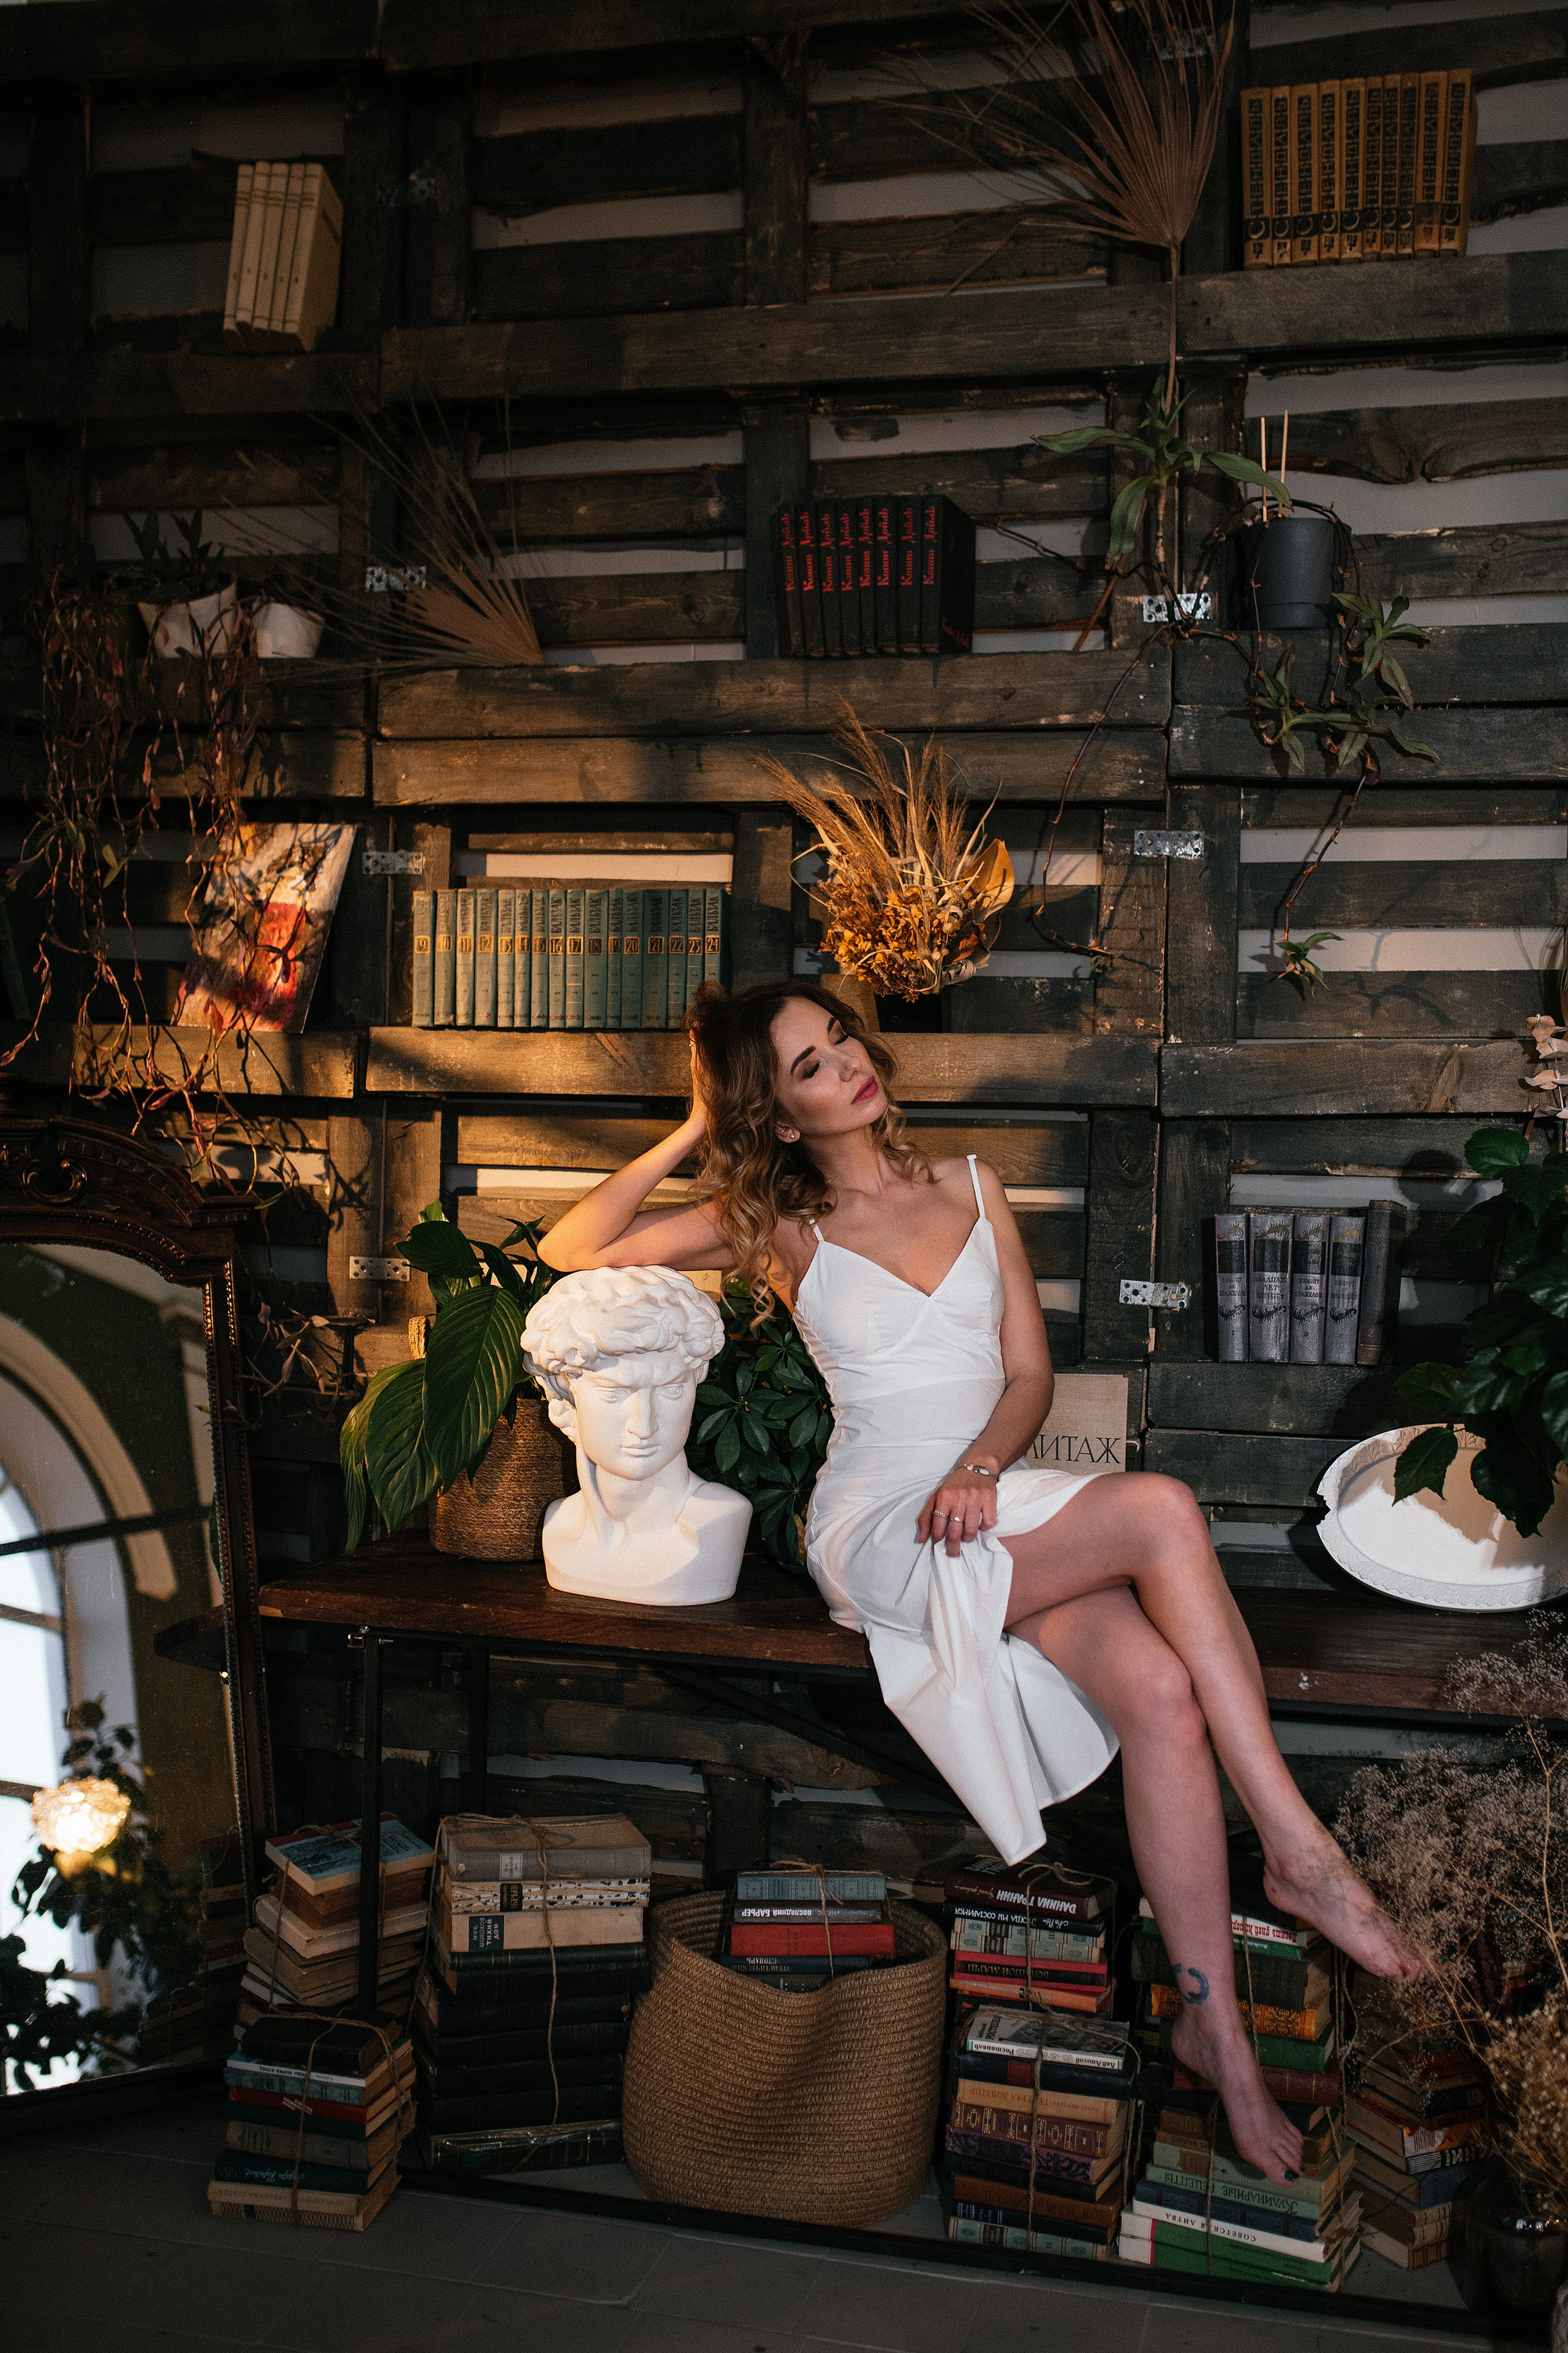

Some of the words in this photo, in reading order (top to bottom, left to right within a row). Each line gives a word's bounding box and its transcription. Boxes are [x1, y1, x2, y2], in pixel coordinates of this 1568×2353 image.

[1248, 99, 1265, 239] СТЕНДАЛЬ
[1274, 97, 1289, 238] СТЕНДАЛЬ
[1296, 95, 1313, 236] СТЕНДАЛЬ
[1321, 94, 1336, 232] СТЕНДАЛЬ
[1343, 89, 1360, 230] СТЕНДАЛЬ
[1364, 88, 1381, 227] СТЕНДАЛЬ
[781, 513, 795, 548] Дойль
[799, 512, 815, 547] Дойль
[820, 513, 835, 549] Дойль
[839, 513, 854, 548] Дойль
[858, 508, 873, 544] Дойль
[876, 508, 892, 544] Дойль
[901, 507, 916, 543] Дойль
[924, 506, 938, 543] Дойль
[785, 556, 795, 591] Конан
[803, 554, 814, 591] Конан
[822, 556, 834, 592] Конан
[841, 555, 853, 591] Конан
[859, 550, 870, 587] Конан
[877, 550, 889, 586] Конан
[900, 550, 913, 586] Конан
[922, 549, 935, 585] Конан
[480, 898, 492, 931] БАЛЬЗАК
[501, 898, 512, 932] БАЛЬЗАК
[534, 897, 545, 932] БАЛЬЗАК
[551, 897, 562, 934] БАЛЬЗАК
[570, 897, 581, 933] БАЛЬЗАК
[589, 897, 601, 934] БАЛЬЗАК
[609, 897, 622, 932] БАЛЬЗАК
[627, 896, 638, 932] БАЛЬЗАК
[671, 896, 682, 932] БАЛЬЗАК
[690, 897, 701, 933] БАЛЬЗАК
[707, 896, 718, 932] БАЛЬЗАК
[420, 940, 426, 951] 9
[440, 938, 450, 950] 10
[461, 939, 470, 951] 11
[481, 937, 491, 951] 12
[502, 939, 511, 952] 13
[518, 938, 527, 951] 14
[534, 939, 546, 952] 15
[551, 940, 562, 953] 16
[570, 939, 581, 953] 17
[589, 939, 601, 953] 18
[610, 939, 620, 953] 19
[626, 939, 638, 952] 20
[652, 939, 662, 951] 21
[671, 939, 682, 951] 22
[689, 940, 700, 953] 23
[707, 938, 718, 951] 24
[1367, 1328, 1374, 1337] 2
[741, 1909, 771, 1917] БАРЬЕР
[955, 1907, 996, 1920] СОСТАРИМСЯ
[995, 1889, 1035, 1906] ГРАНИН
[1037, 1896, 1077, 1914] ДАНИИЛ
[1231, 1920, 1253, 1935] котор
[1272, 1929, 1297, 1943] Десять
[967, 1964, 1000, 1974] МАРШ
[1002, 1966, 1049, 1979] БОЛШОЙ
[974, 2044, 1015, 2056] Ростепель
[1076, 2057, 1101, 2066] Анисов
[970, 2088, 1008, 2101] ДОВАТОР
[1010, 2093, 1048, 2106] ГЕЕРАЛ
[1222, 2185, 1298, 2215] КУЛИНАРНЫЕ
[1165, 2213, 1196, 2226] ЛИТВА
[1200, 2222, 1256, 2242] СОВЕТСКЯ
